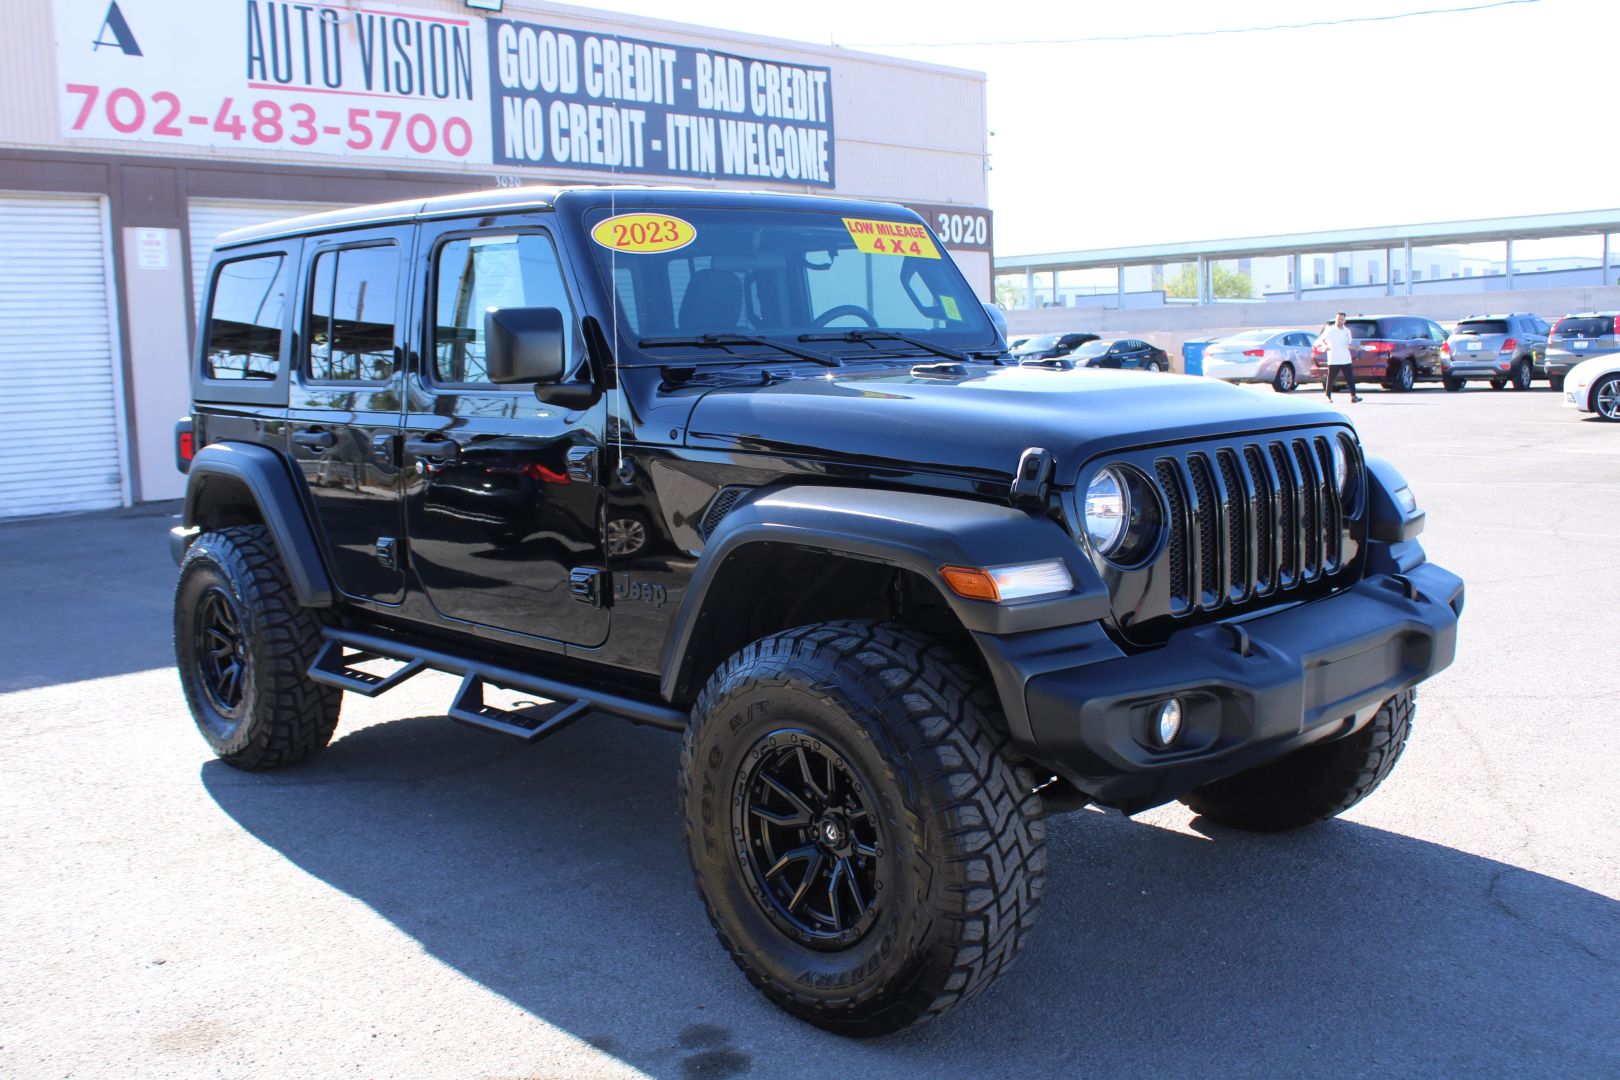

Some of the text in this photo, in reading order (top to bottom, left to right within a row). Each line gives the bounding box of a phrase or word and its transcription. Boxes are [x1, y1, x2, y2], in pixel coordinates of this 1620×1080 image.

[246, 0, 474, 101] AUTO VISION
[497, 23, 579, 94] GOOD
[583, 36, 677, 106] CREDIT
[695, 53, 746, 114] BAD
[749, 61, 828, 123] CREDIT
[66, 83, 474, 157] 702-483-5700
[502, 96, 545, 162] NO
[549, 100, 646, 169] CREDIT
[666, 112, 717, 174] ITIN
[718, 117, 830, 184] WELCOME
[612, 220, 680, 247] 2023
[846, 220, 927, 239] LOW MILEAGE
[938, 213, 987, 245] 3020
[616, 573, 668, 609] Jeep
[728, 700, 770, 736] R/T
[701, 743, 724, 858] TOYO
